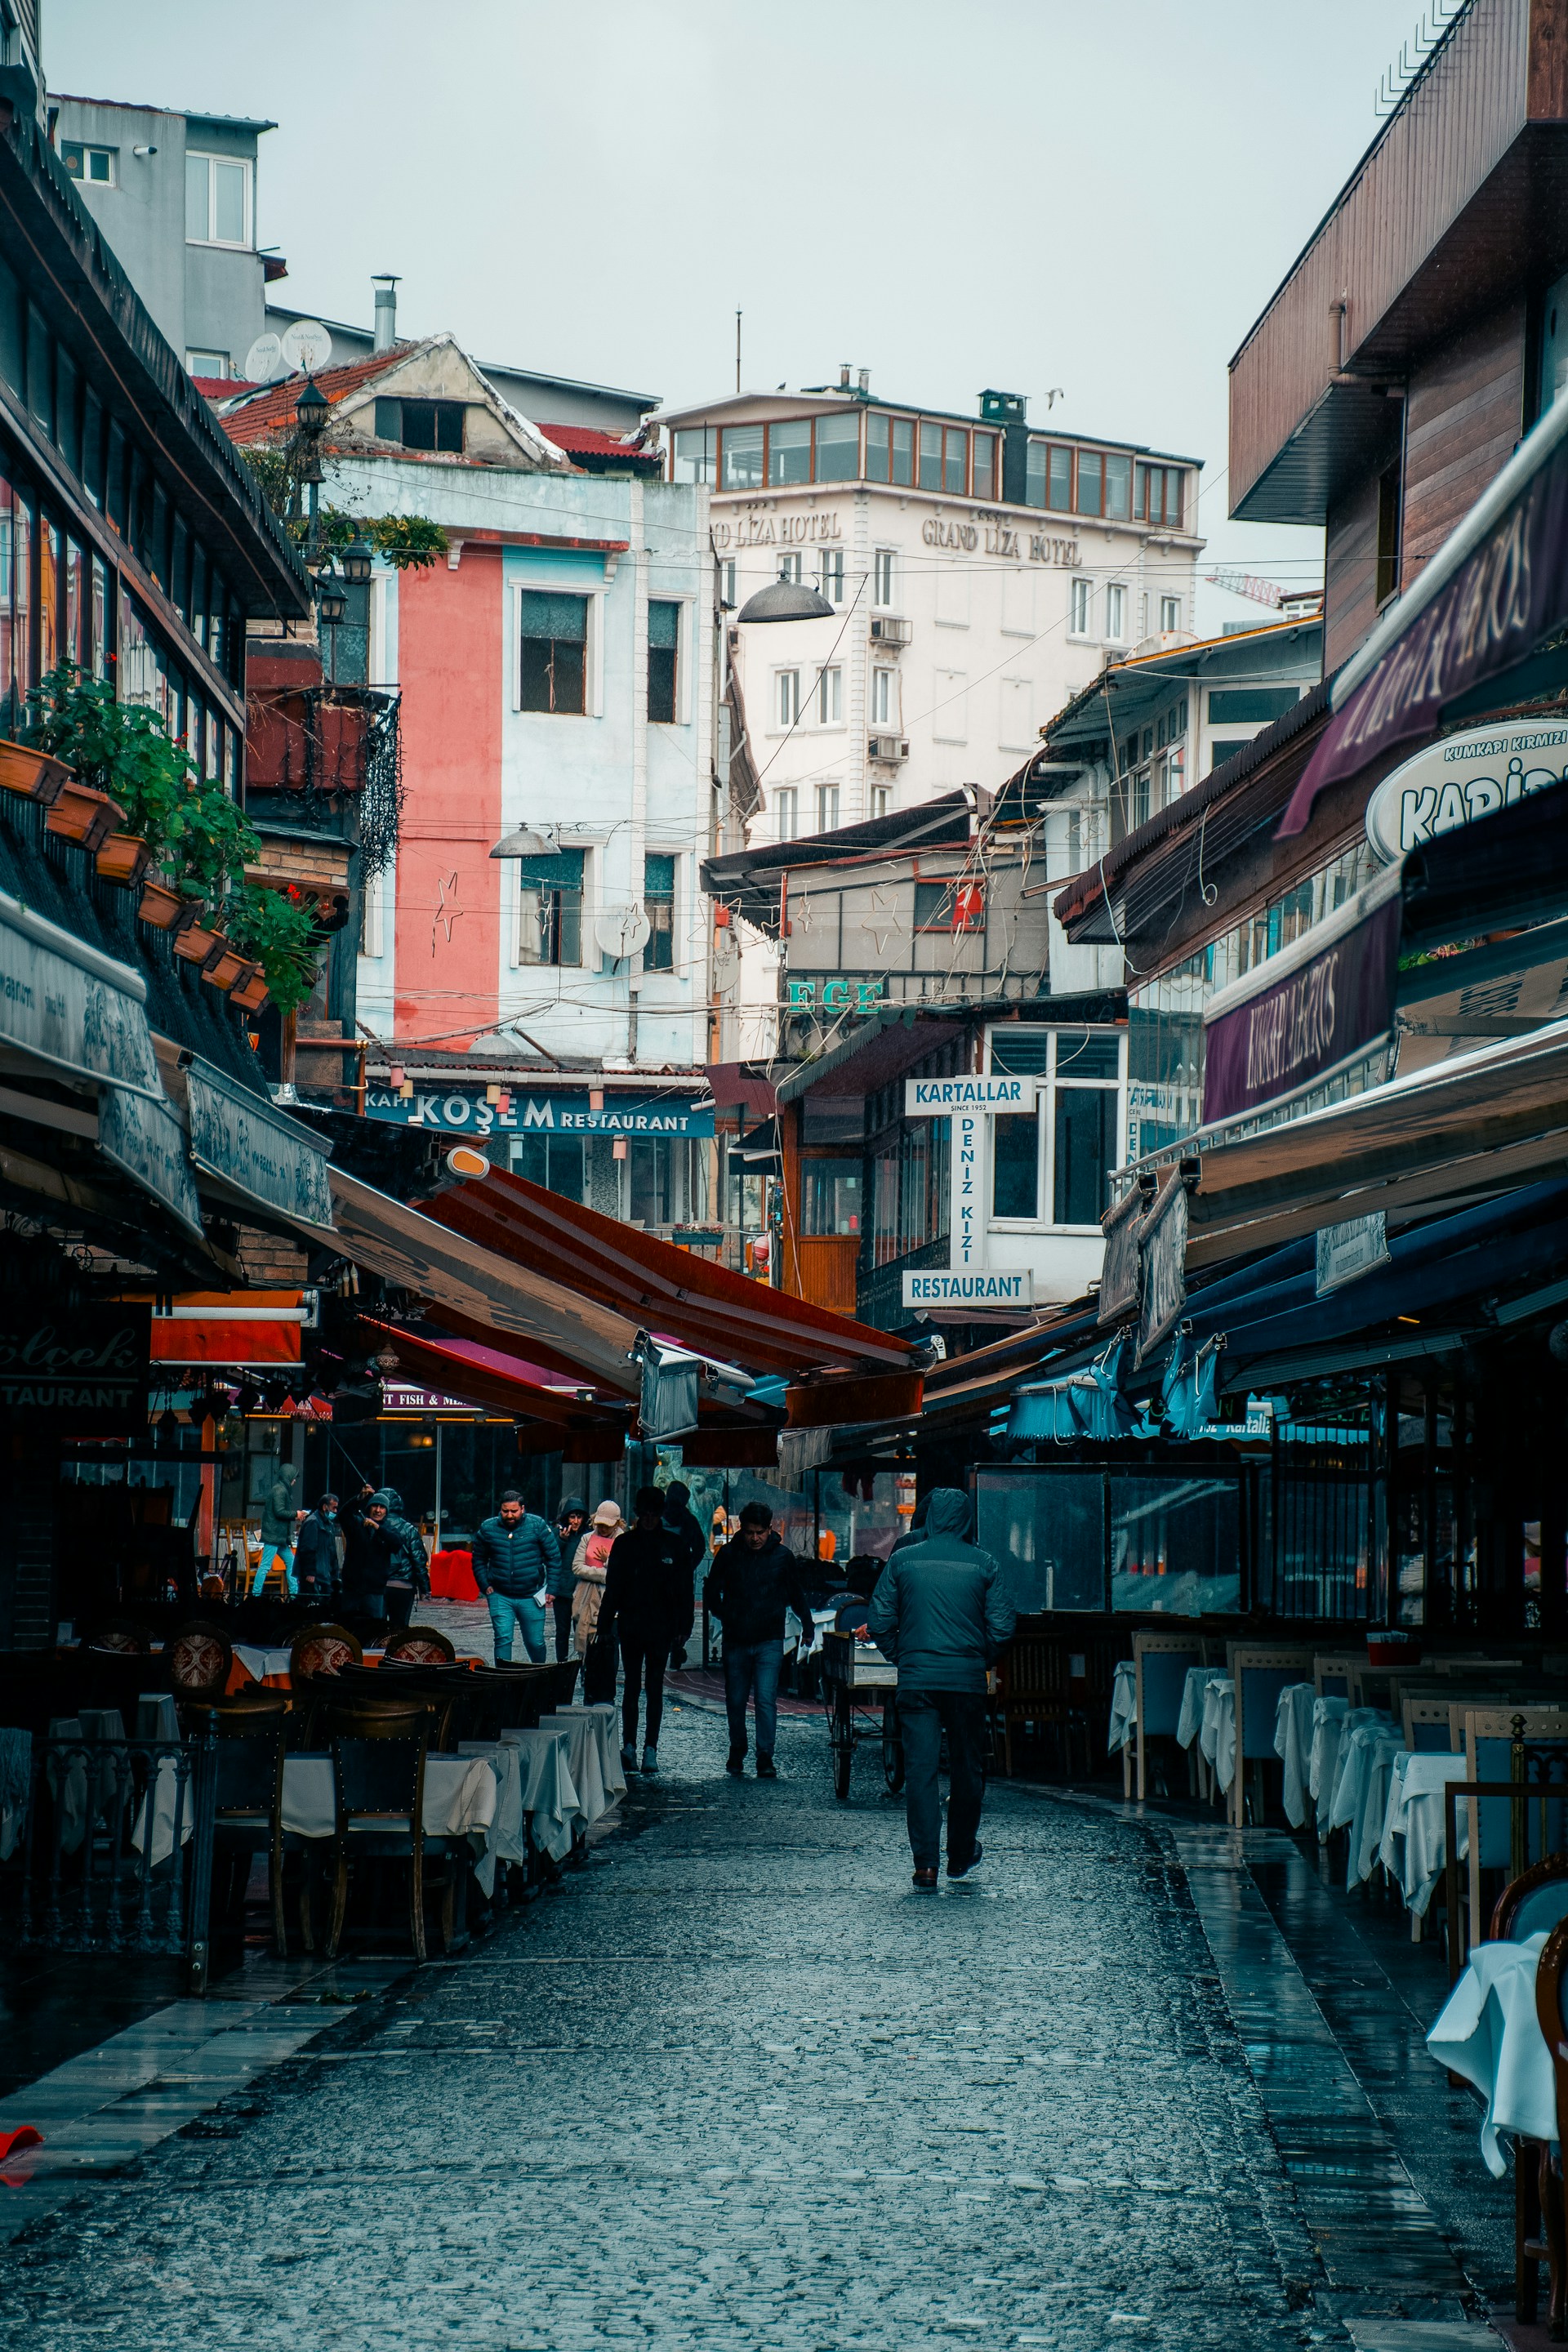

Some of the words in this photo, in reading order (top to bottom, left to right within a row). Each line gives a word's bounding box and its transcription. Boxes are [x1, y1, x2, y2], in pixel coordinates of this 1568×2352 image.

[779, 511, 842, 542] HOTEL
[922, 517, 979, 551] GRAND
[1029, 533, 1083, 567] HOTEL
[1444, 738, 1508, 762] KUMKAPI
[1511, 730, 1568, 752] KIRMIZI
[786, 981, 884, 1014] EGE
[915, 1081, 1022, 1103] KARTALLAR
[415, 1089, 555, 1135] KÖŞEM
[560, 1111, 689, 1131] RESTAURANT
[960, 1118, 974, 1194] DENİZ
[960, 1206, 974, 1263] KIZI
[911, 1276, 1022, 1298] RESTAURANT
[399, 1394, 425, 1405] FISH
[428, 1394, 439, 1405] &
